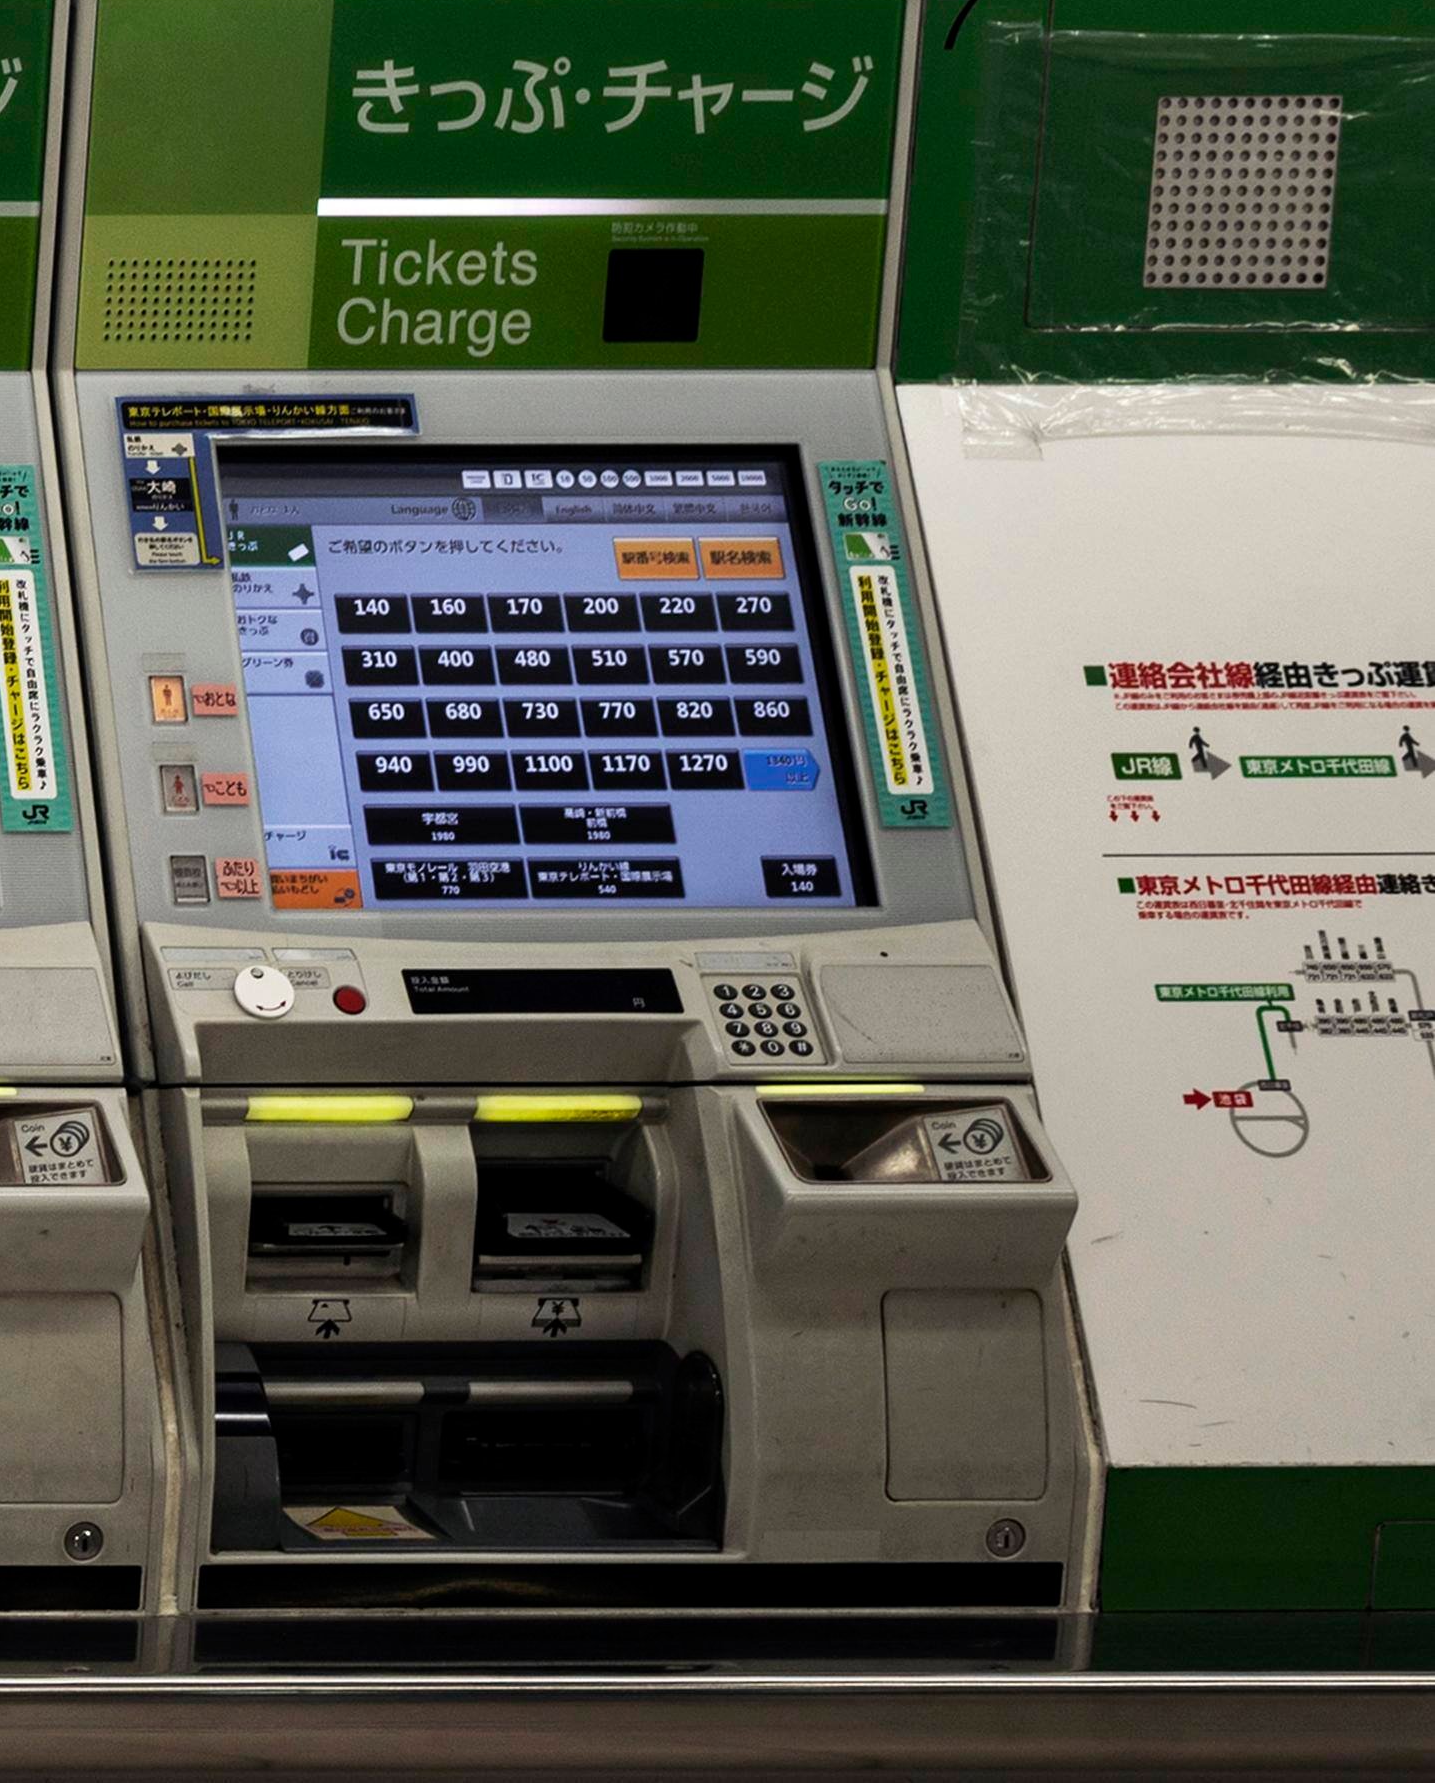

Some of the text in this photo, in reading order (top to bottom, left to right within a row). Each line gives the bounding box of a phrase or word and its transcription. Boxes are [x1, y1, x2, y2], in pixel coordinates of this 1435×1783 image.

[352, 55, 874, 134] きっぷ・チャージ
[341, 238, 538, 286] Tickets
[337, 297, 532, 358] Charge
[599, 702, 636, 719] 770
[676, 702, 713, 718] 820
[754, 701, 790, 718] 860
[1122, 758, 1173, 776] JR線
[1245, 759, 1392, 775] 東京メトロ千代田線
